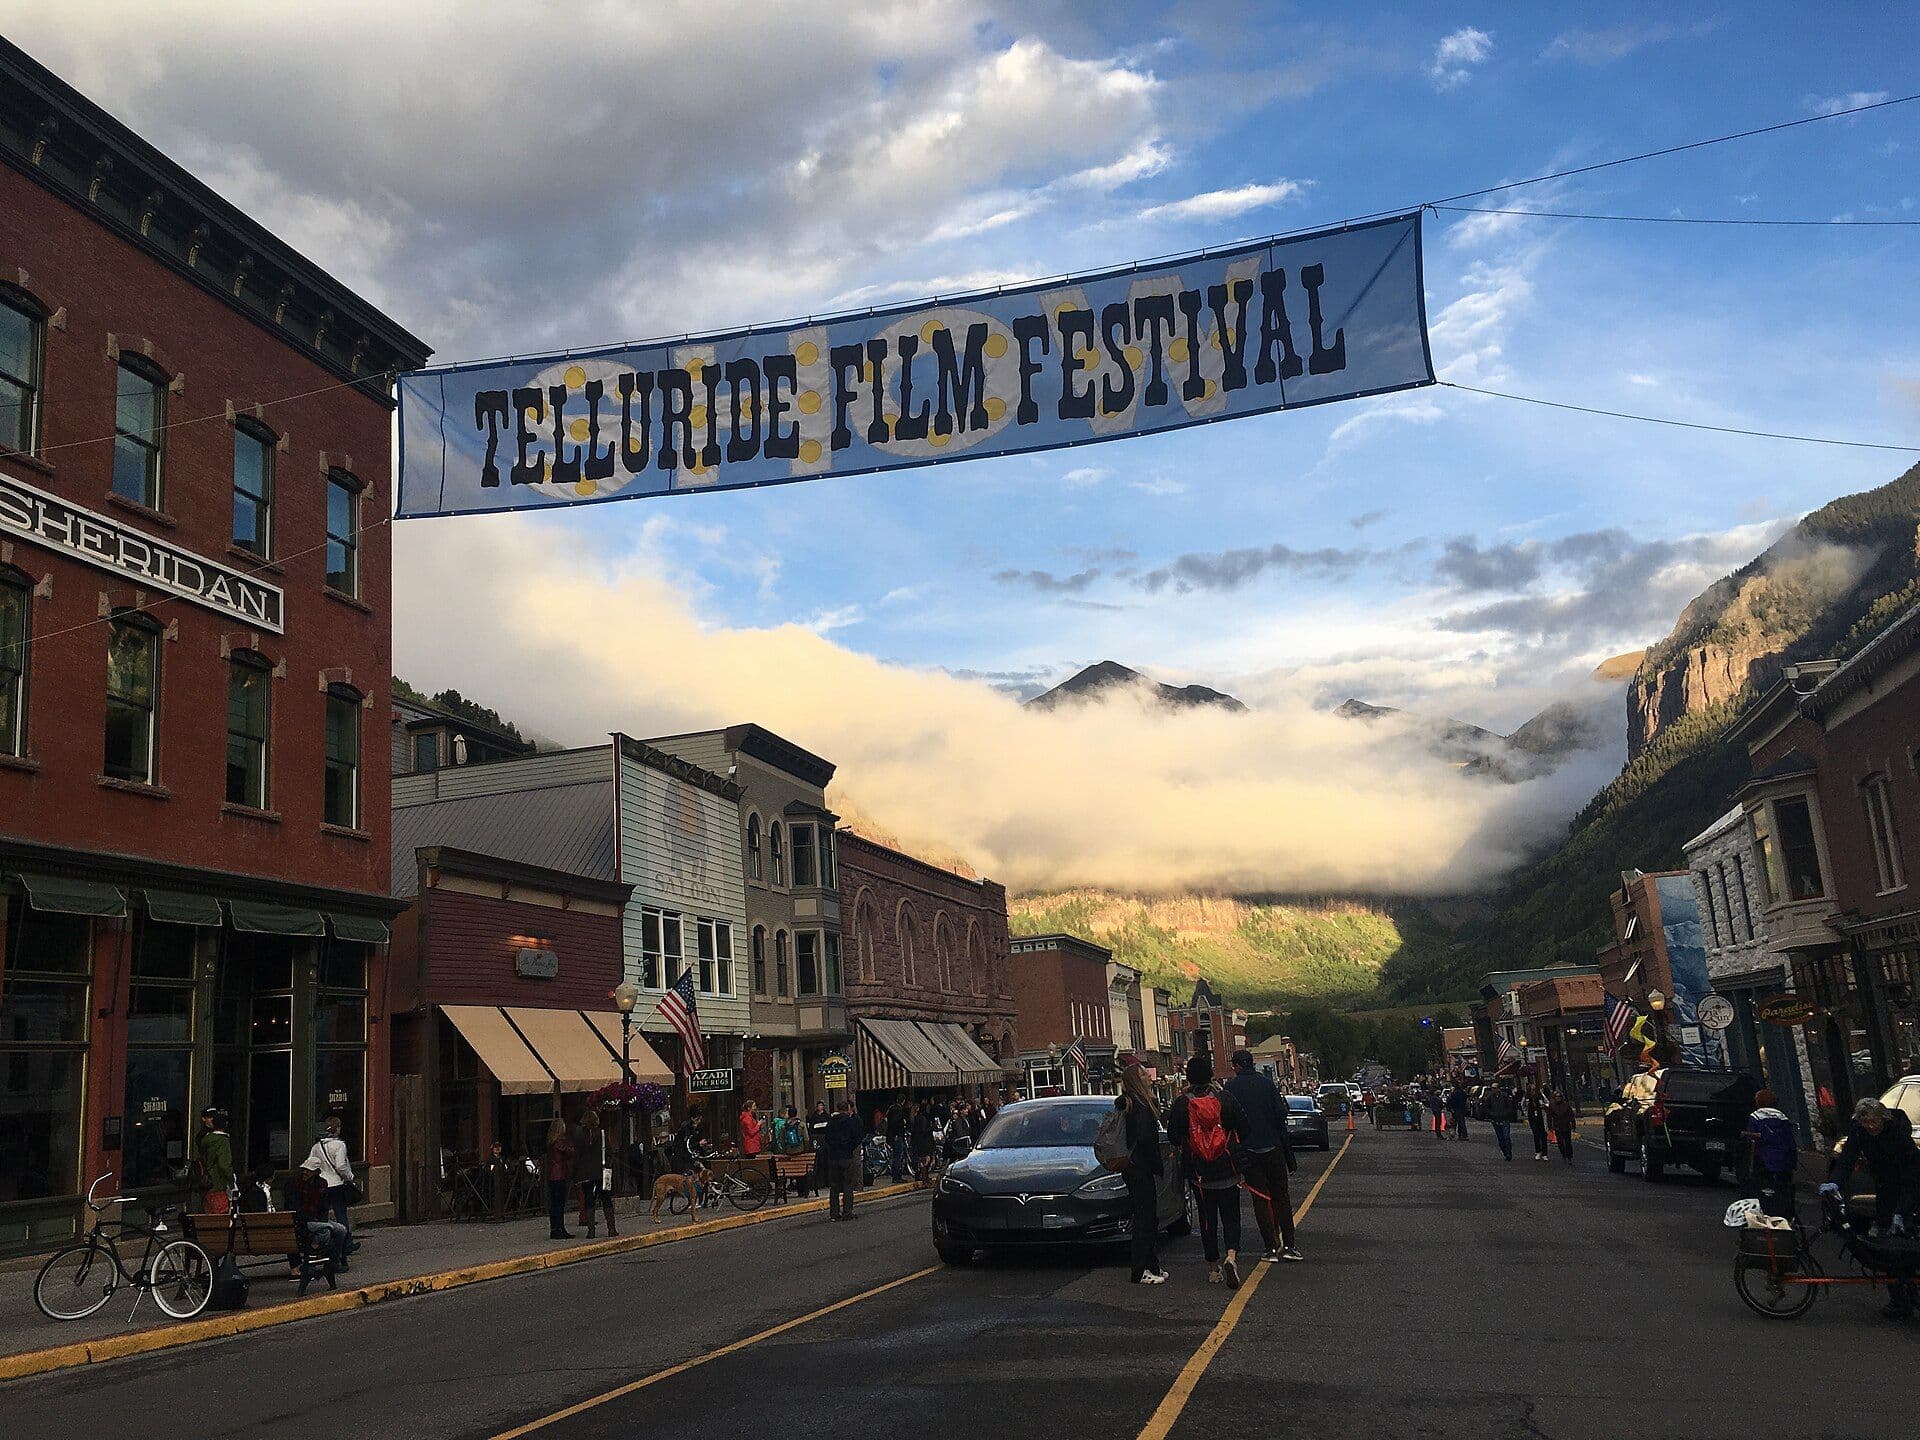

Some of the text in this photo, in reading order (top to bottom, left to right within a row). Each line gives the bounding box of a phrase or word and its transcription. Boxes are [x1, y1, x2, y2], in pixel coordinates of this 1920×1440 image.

[475, 262, 1347, 488] TELLURIDE FILM FESTIVAL
[692, 1071, 729, 1080] AZADI
[692, 1080, 709, 1088] FINE
[710, 1078, 729, 1086] RUGS
